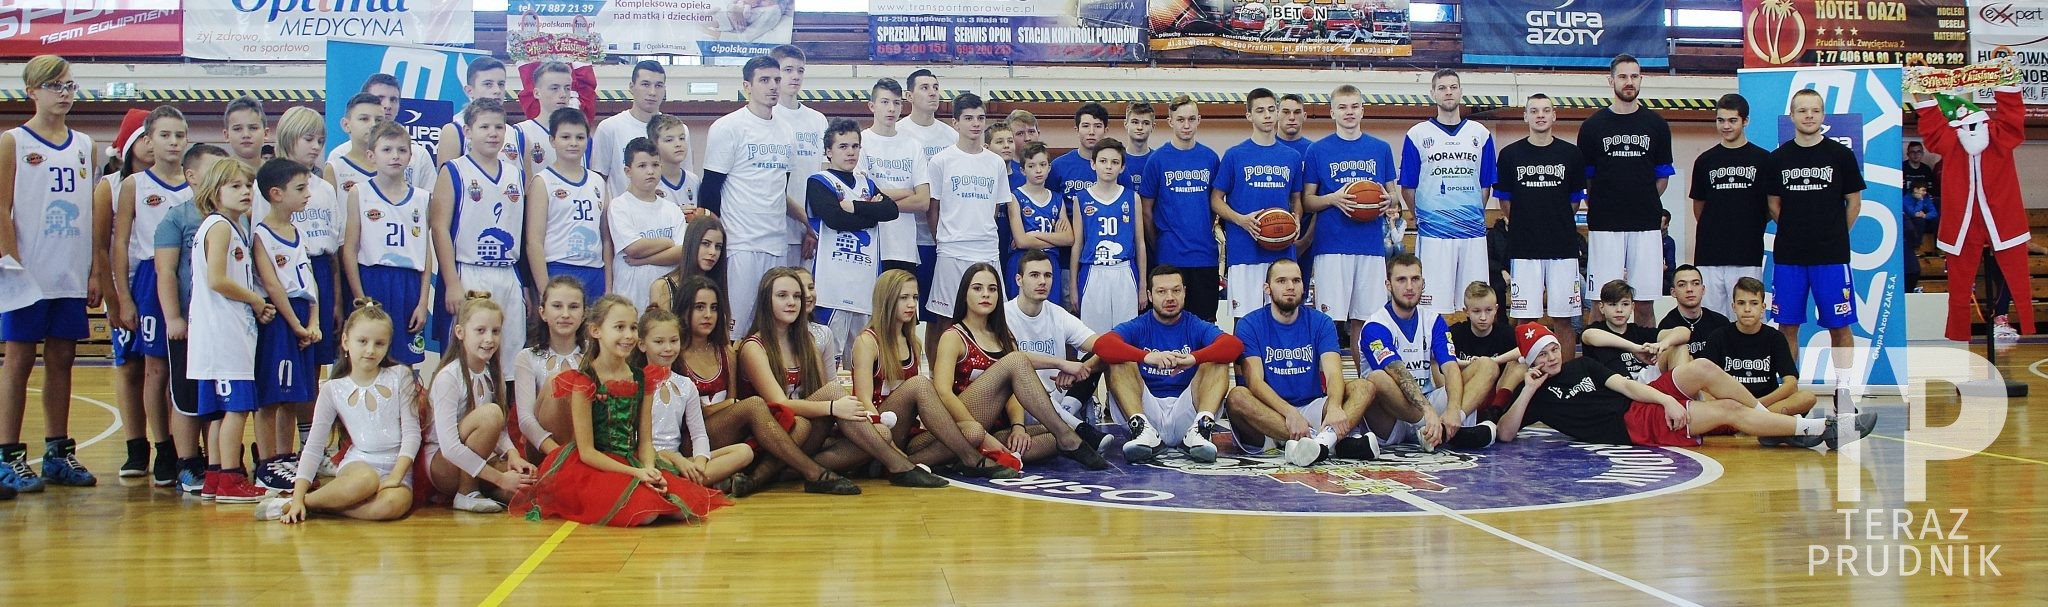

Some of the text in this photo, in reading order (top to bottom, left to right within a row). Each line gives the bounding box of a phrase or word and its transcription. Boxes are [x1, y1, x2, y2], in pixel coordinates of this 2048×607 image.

[535, 5, 548, 13] 77
[548, 5, 566, 13] 887
[568, 5, 579, 13] 21
[582, 5, 594, 13] 39
[680, 1, 712, 11] opieka
[877, 3, 1035, 14] www.transportmorawiec.pl
[1815, 0, 1907, 21] HOTEL OAZA
[1937, 7, 1965, 16] NOCLEGI
[613, 12, 631, 20] nad
[633, 12, 660, 21] matką
[667, 12, 713, 22] dzieckiem
[40, 9, 176, 45] TEAM EQUIPMENT
[280, 18, 404, 36] MEDYCYNA
[1938, 19, 1966, 29] WESELA
[877, 24, 920, 42] SPRZEDAŻ
[921, 25, 947, 42] PALIW
[954, 26, 987, 43] SERWIS
[988, 26, 1011, 43] OPON
[1933, 31, 1966, 41] KATERING
[243, 42, 310, 54] na sportowo
[1815, 39, 1846, 47] Prudnik
[750, 46, 770, 55] mam
[1816, 51, 1824, 63] T:
[1826, 51, 1836, 63] 77
[1840, 51, 1861, 63] 406
[1894, 52, 1903, 64] T:
[1926, 52, 1945, 64] 626
[1427, 151, 1478, 163] MORAWIEC
[49, 167, 76, 192] 33
[1789, 183, 1823, 191] BASKETBALL
[493, 202, 502, 224] 9
[573, 199, 593, 221] 32
[1098, 216, 1118, 236] 30
[386, 222, 405, 247] 21
[832, 251, 872, 264] PTBS
[1273, 366, 1307, 375] BASKETBALL
